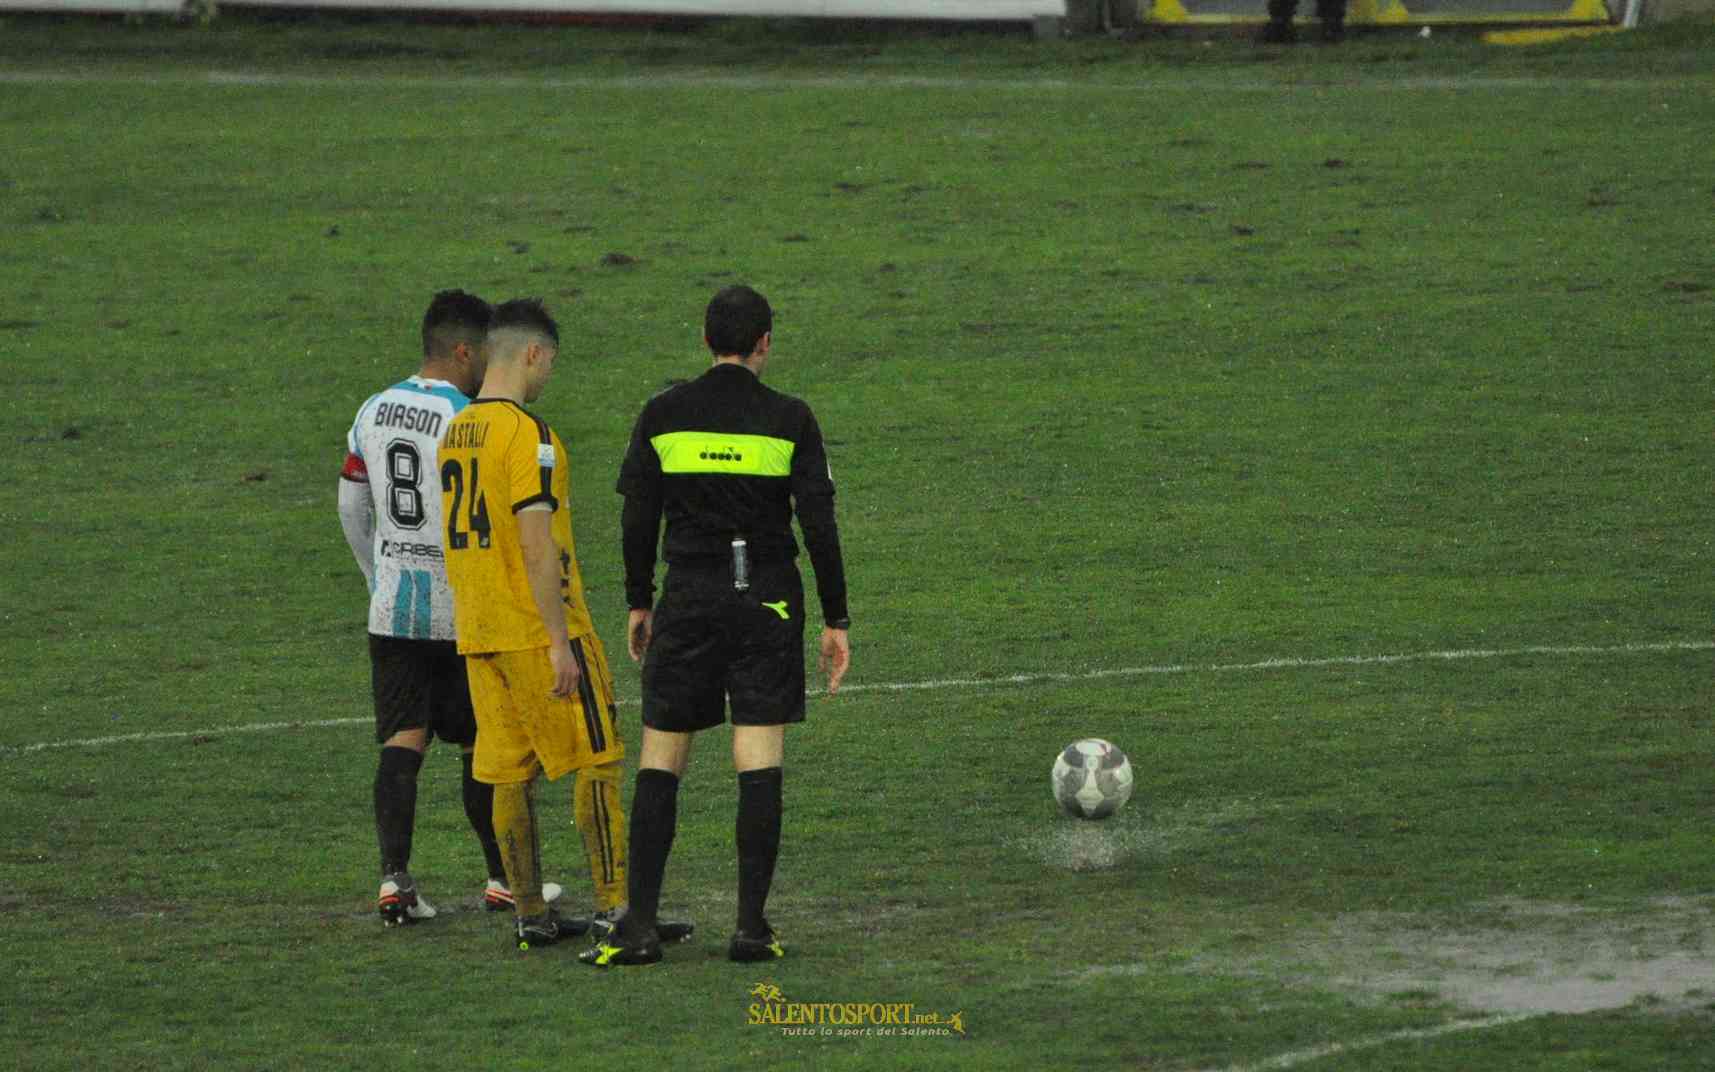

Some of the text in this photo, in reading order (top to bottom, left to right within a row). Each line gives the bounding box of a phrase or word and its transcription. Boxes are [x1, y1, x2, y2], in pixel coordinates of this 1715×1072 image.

[374, 402, 441, 437] BIASON
[386, 438, 427, 531] 8
[441, 457, 491, 550] 24
